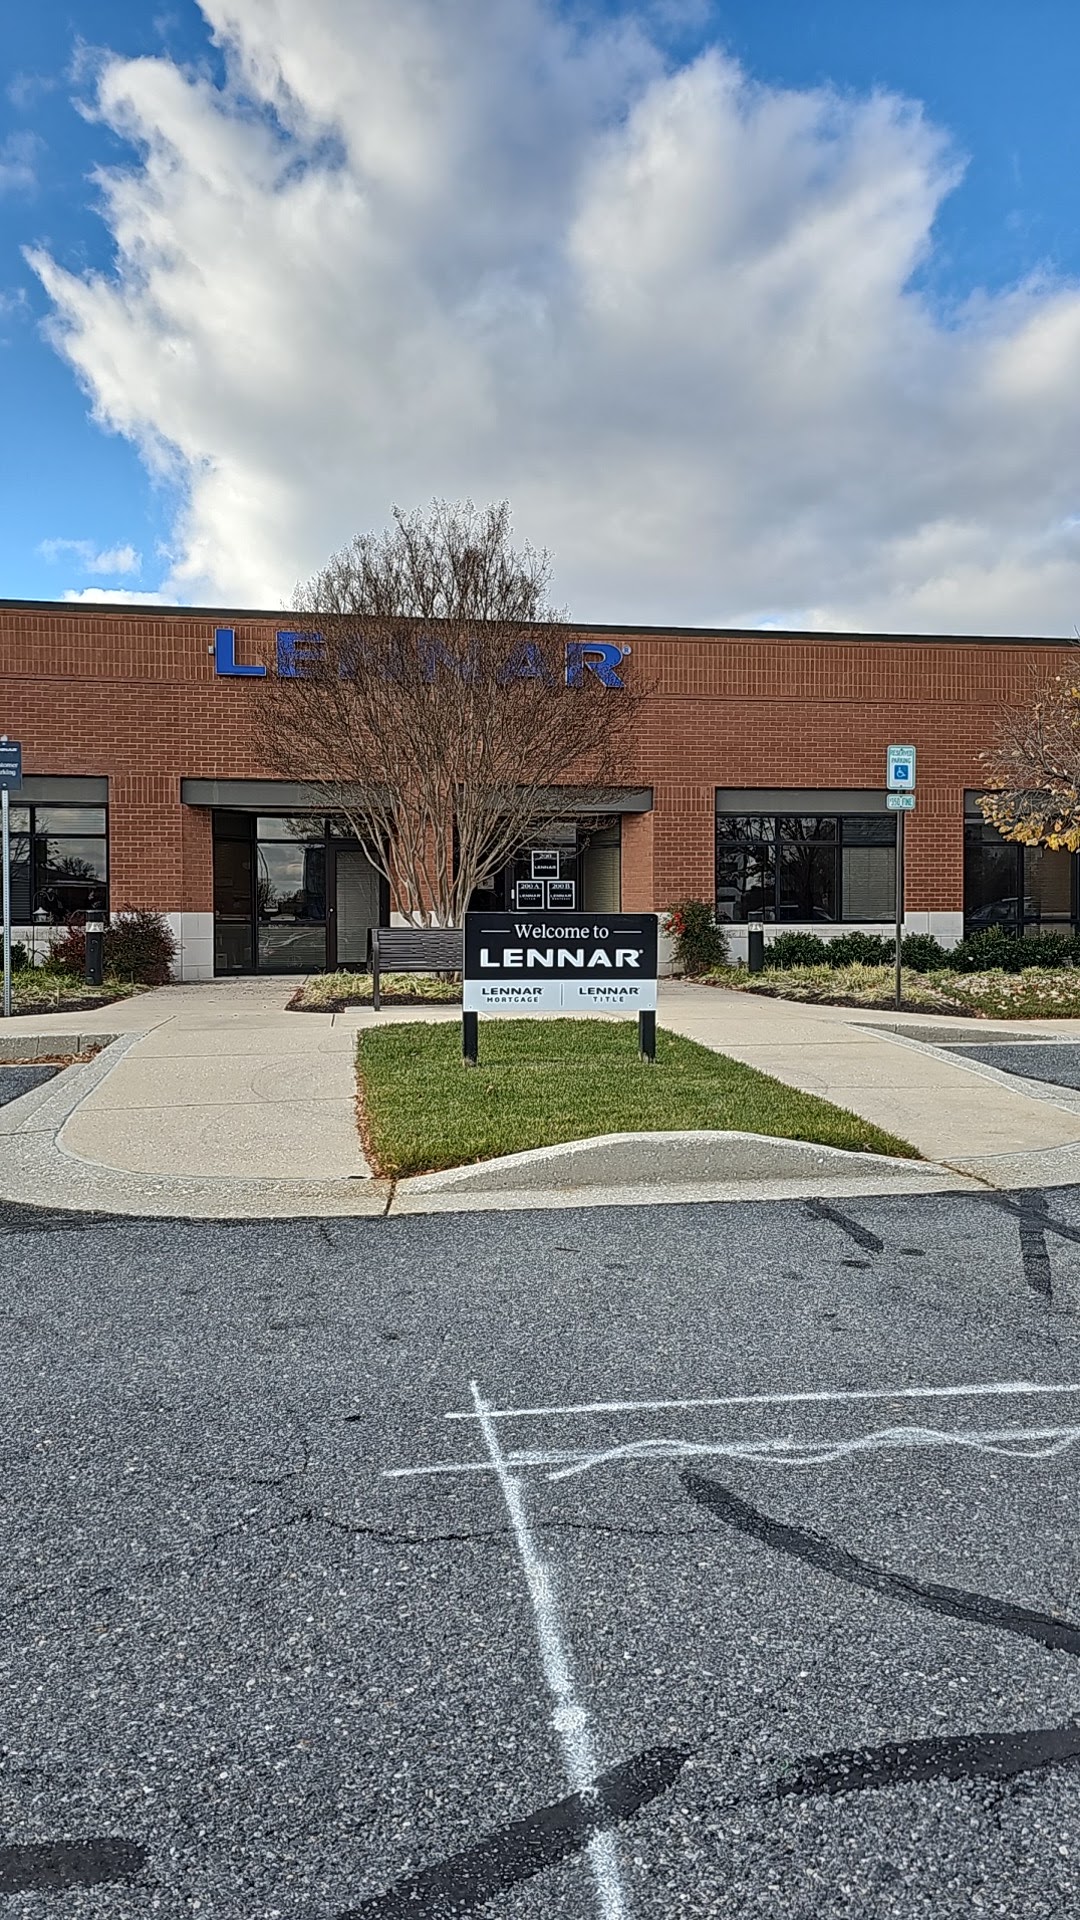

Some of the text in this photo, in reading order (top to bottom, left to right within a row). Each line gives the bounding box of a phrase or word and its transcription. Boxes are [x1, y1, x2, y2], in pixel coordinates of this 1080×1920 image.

[902, 797, 912, 806] FINE
[514, 924, 610, 939] Welcome to
[481, 987, 544, 995] LENNAR
[579, 987, 640, 995] LENNAR
